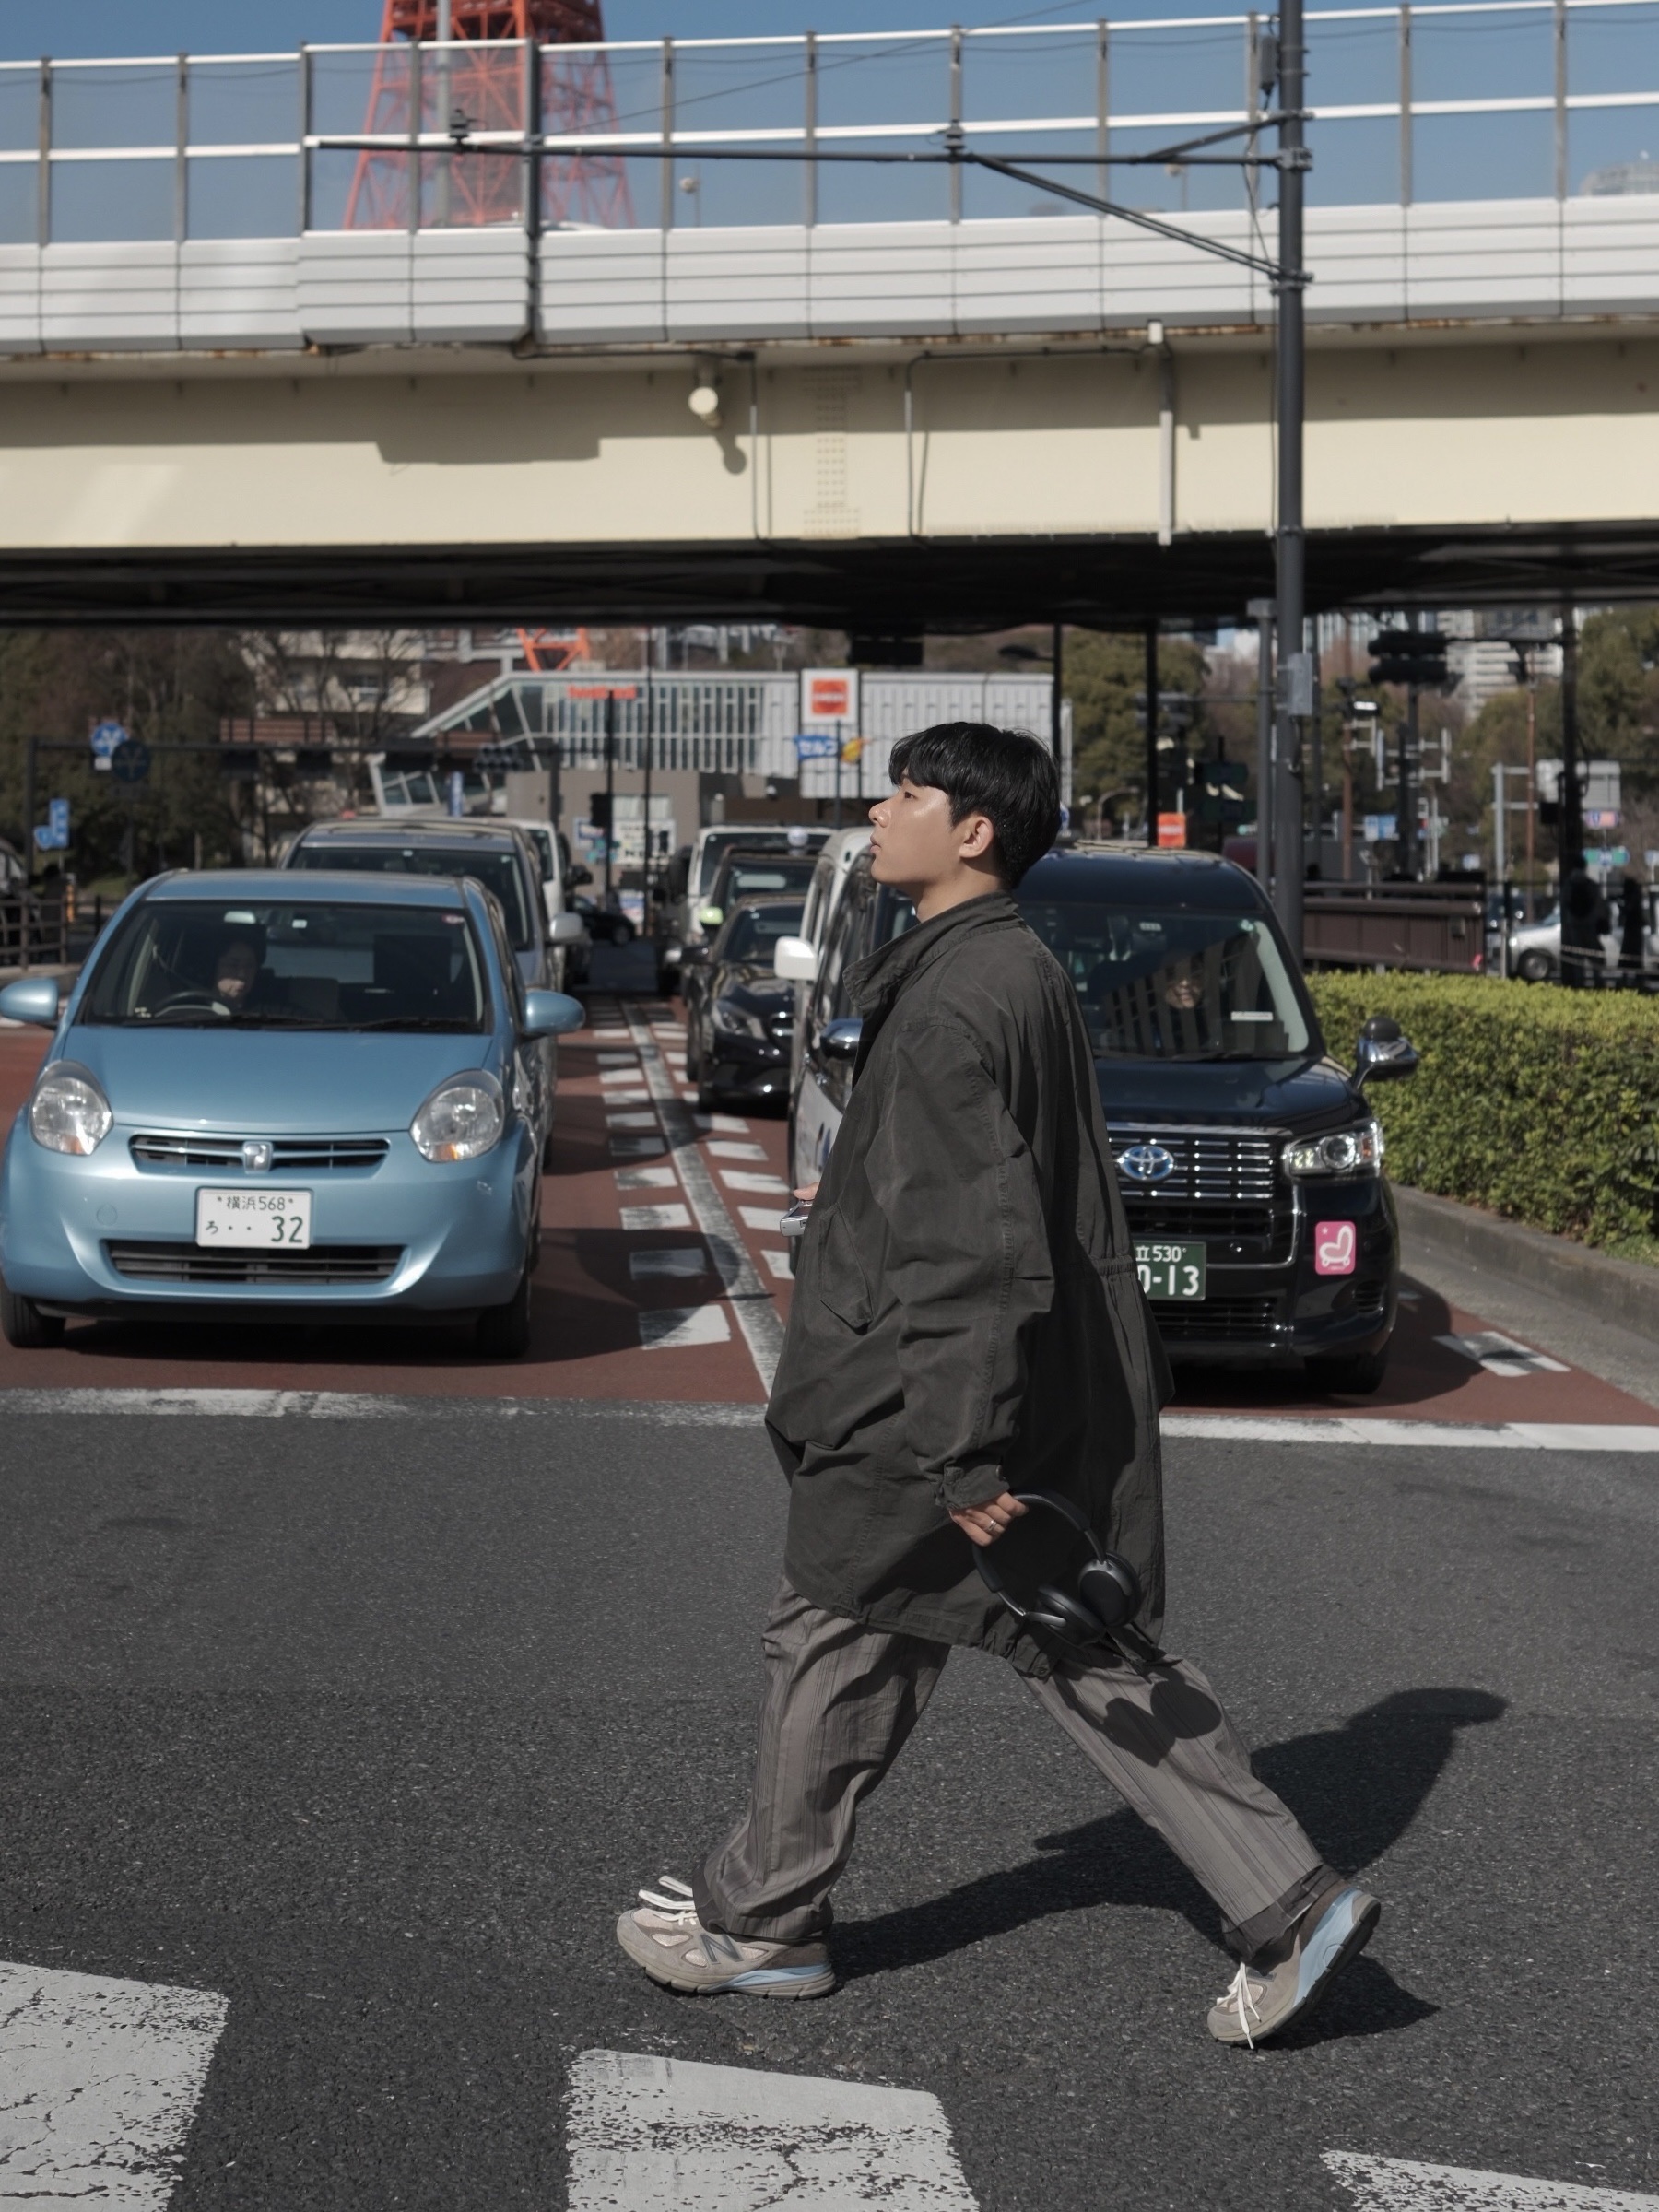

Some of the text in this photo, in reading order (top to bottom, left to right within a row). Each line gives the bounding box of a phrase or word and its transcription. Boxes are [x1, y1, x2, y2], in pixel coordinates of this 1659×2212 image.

[226, 1195, 286, 1211] 横浜568
[206, 1220, 219, 1235] ろ
[271, 1215, 303, 1243] 32
[700, 1934, 745, 1965] N
